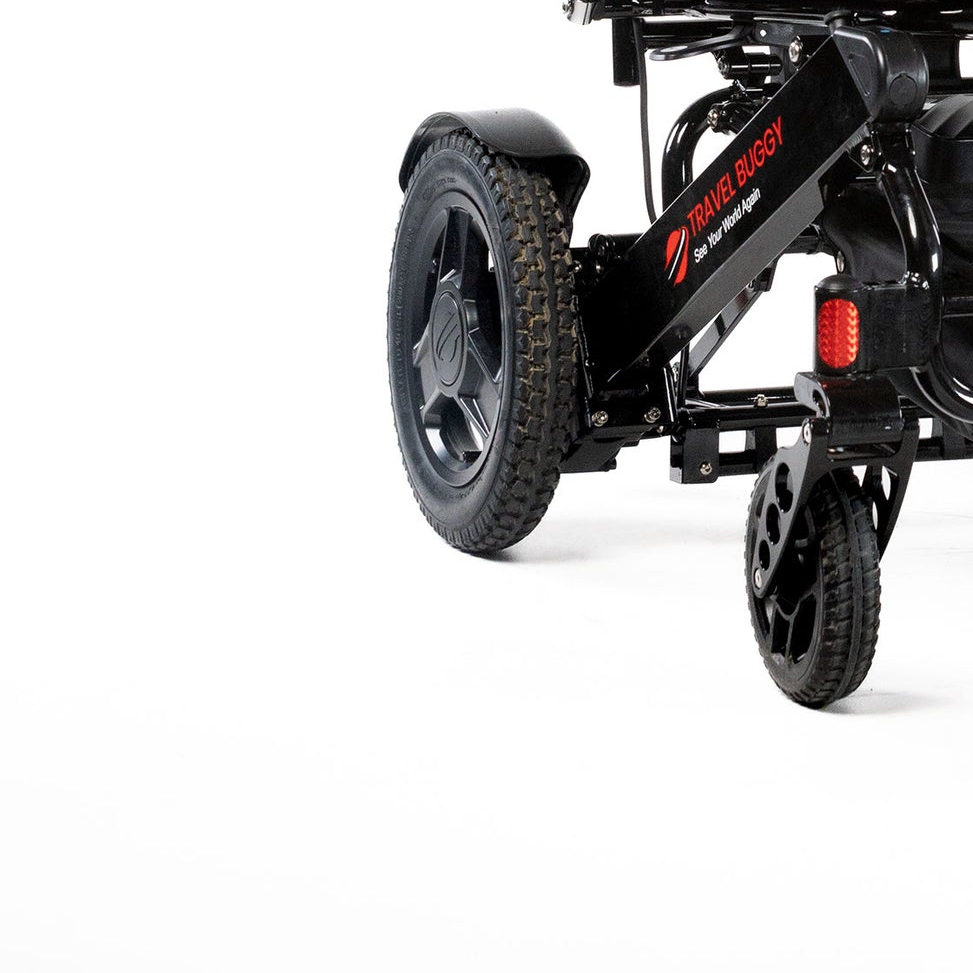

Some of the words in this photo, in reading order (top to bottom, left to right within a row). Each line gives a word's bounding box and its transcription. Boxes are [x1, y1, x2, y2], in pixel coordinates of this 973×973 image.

[687, 172, 737, 237] TRAVEL
[735, 116, 784, 186] BUGGY
[693, 242, 708, 263] See
[707, 229, 723, 249] Your
[721, 204, 743, 234] World
[740, 187, 762, 215] Again
